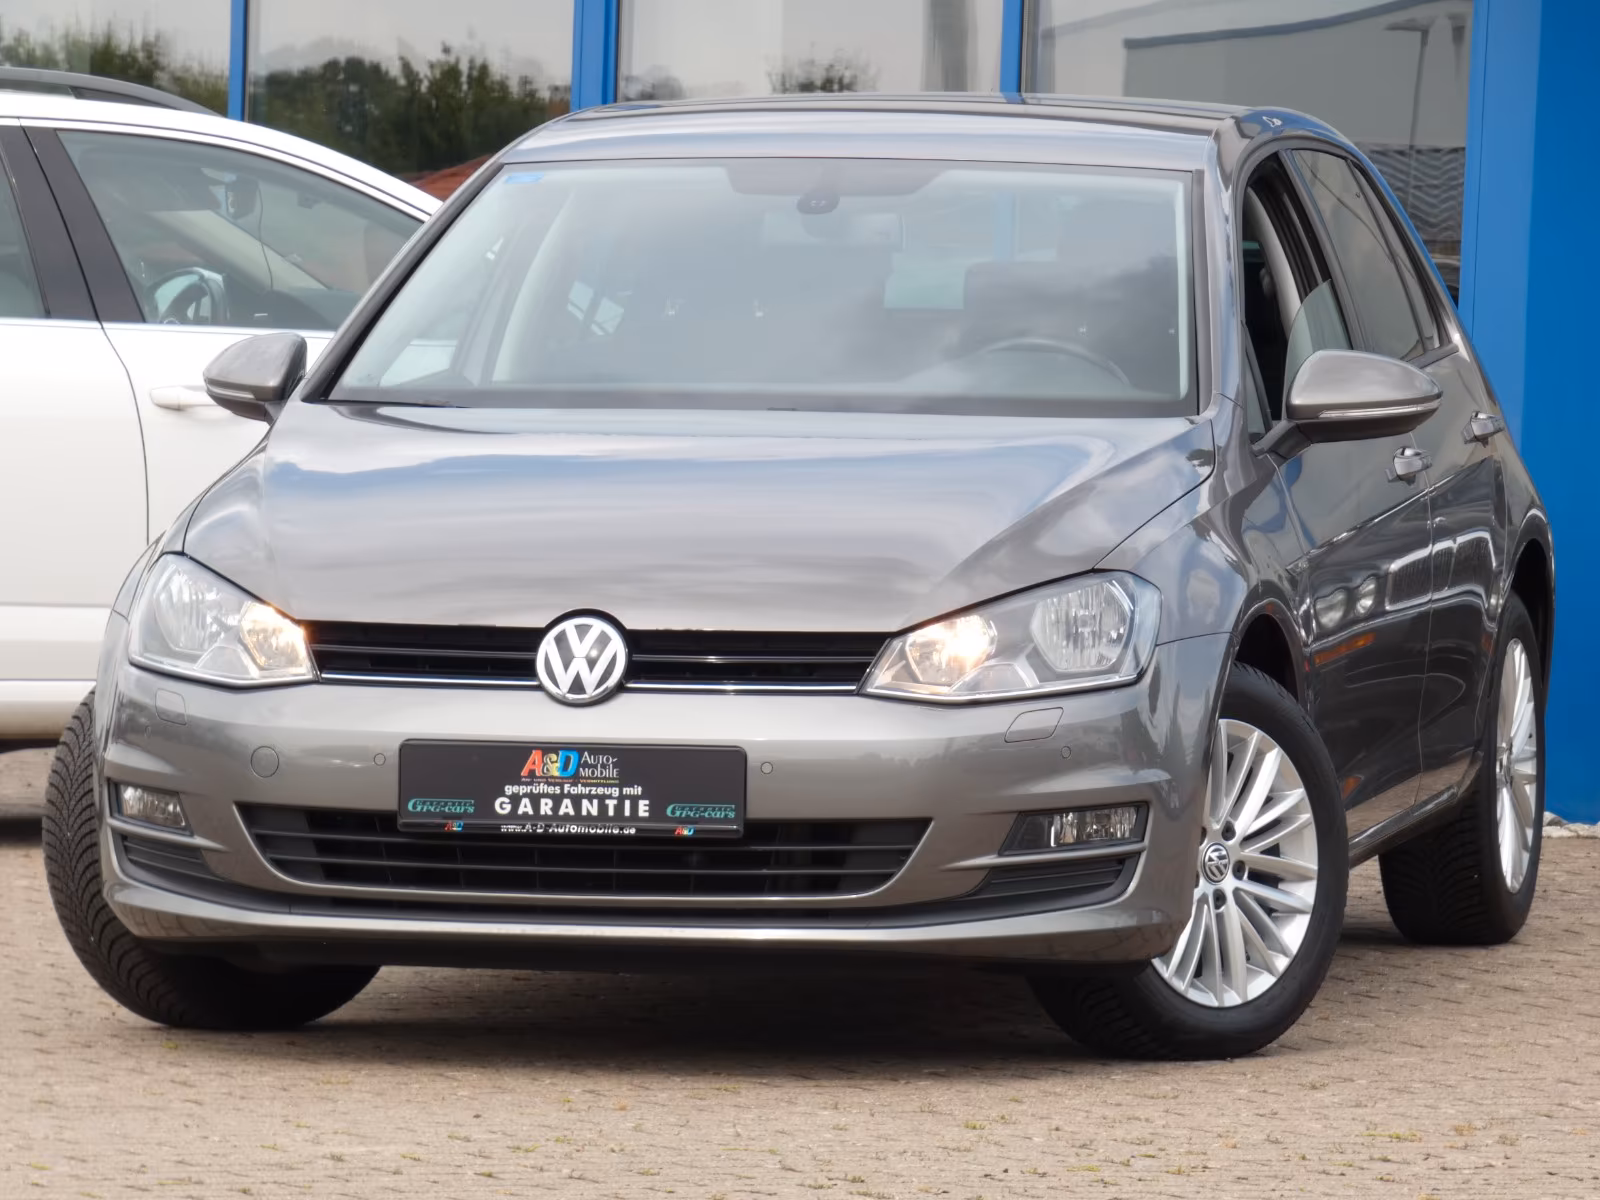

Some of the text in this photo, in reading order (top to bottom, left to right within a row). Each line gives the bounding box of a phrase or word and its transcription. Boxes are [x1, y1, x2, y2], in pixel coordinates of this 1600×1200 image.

[520, 749, 579, 777] A&D
[504, 783, 643, 797] geprüftes Fahrzeug mit
[494, 797, 650, 817] GARANTIE
[500, 822, 637, 834] www.A-D-Automobile.de
